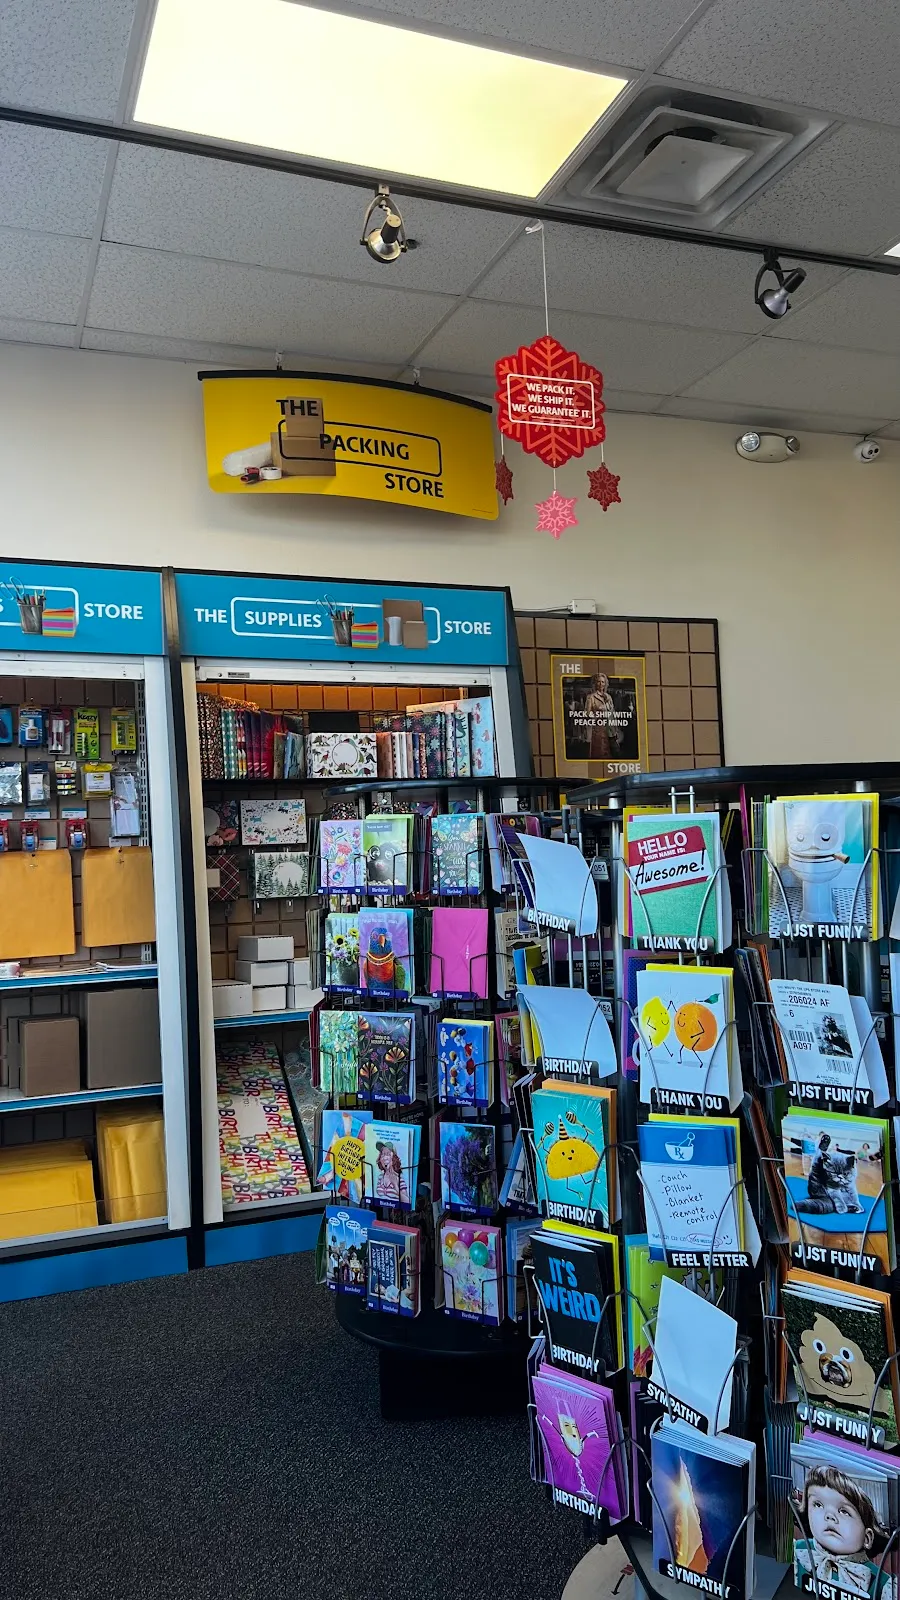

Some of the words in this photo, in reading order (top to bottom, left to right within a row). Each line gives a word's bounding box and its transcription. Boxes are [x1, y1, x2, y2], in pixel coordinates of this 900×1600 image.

[526, 382, 541, 392] WE
[542, 385, 565, 394] PACK
[565, 387, 576, 396] IT.
[276, 399, 319, 416] THE
[527, 394, 543, 403] WE
[543, 395, 564, 405] SHIP
[565, 397, 575, 407] IT.
[511, 403, 527, 412] WE
[527, 405, 580, 418] GUARANTEE
[581, 409, 592, 418] IT.
[319, 433, 409, 460] PACKING
[384, 472, 444, 498] STORE
[83, 602, 144, 620] STORE
[193, 608, 228, 624] THE
[244, 610, 322, 628] SUPPLIES
[444, 619, 492, 635] STORE
[560, 663, 581, 674] THE
[574, 718, 596, 726] PEACE
[608, 719, 629, 727] MIND
[612, 711, 632, 719] WITH
[607, 763, 641, 773] STORE
[637, 831, 688, 856] HELLO
[643, 852, 659, 862] YOUR
[659, 849, 677, 858] NAME
[635, 847, 705, 887] Awesome!
[528, 909, 570, 931] BIRTHDAY
[782, 923, 814, 938] JUST
[818, 924, 863, 939] FUNNY
[642, 935, 682, 950] THANK
[684, 937, 708, 951] YOU
[788, 995, 817, 1006] 206024
[789, 1010, 795, 1018] 6
[793, 1041, 812, 1051] A097
[544, 1058, 593, 1075] BIRTHDAY
[655, 1089, 695, 1107] THANK
[697, 1094, 722, 1110] YOU
[789, 1084, 821, 1099] JUST
[825, 1086, 869, 1105] FUNNY
[549, 1201, 597, 1224] BIRTHDAY
[686, 1211, 718, 1226] control
[671, 1253, 700, 1266] FEEL
[703, 1254, 749, 1267] BETTER
[795, 1244, 827, 1262] JUST
[831, 1250, 876, 1271] FUNNY
[548, 1257, 577, 1288] IT'S
[382, 1304, 399, 1313] Birthday
[539, 1279, 601, 1323] WEIRD
[461, 1311, 479, 1321] Birthday
[552, 1344, 600, 1373] BIRTHDAY
[647, 1383, 702, 1427] SYMPATHY
[800, 1406, 832, 1428] JUST
[835, 1417, 880, 1443] FUNNY
[554, 1488, 602, 1519] BIRTHDAY
[667, 1563, 731, 1599] SYMPATHY
[805, 1578, 837, 1600] JUST
